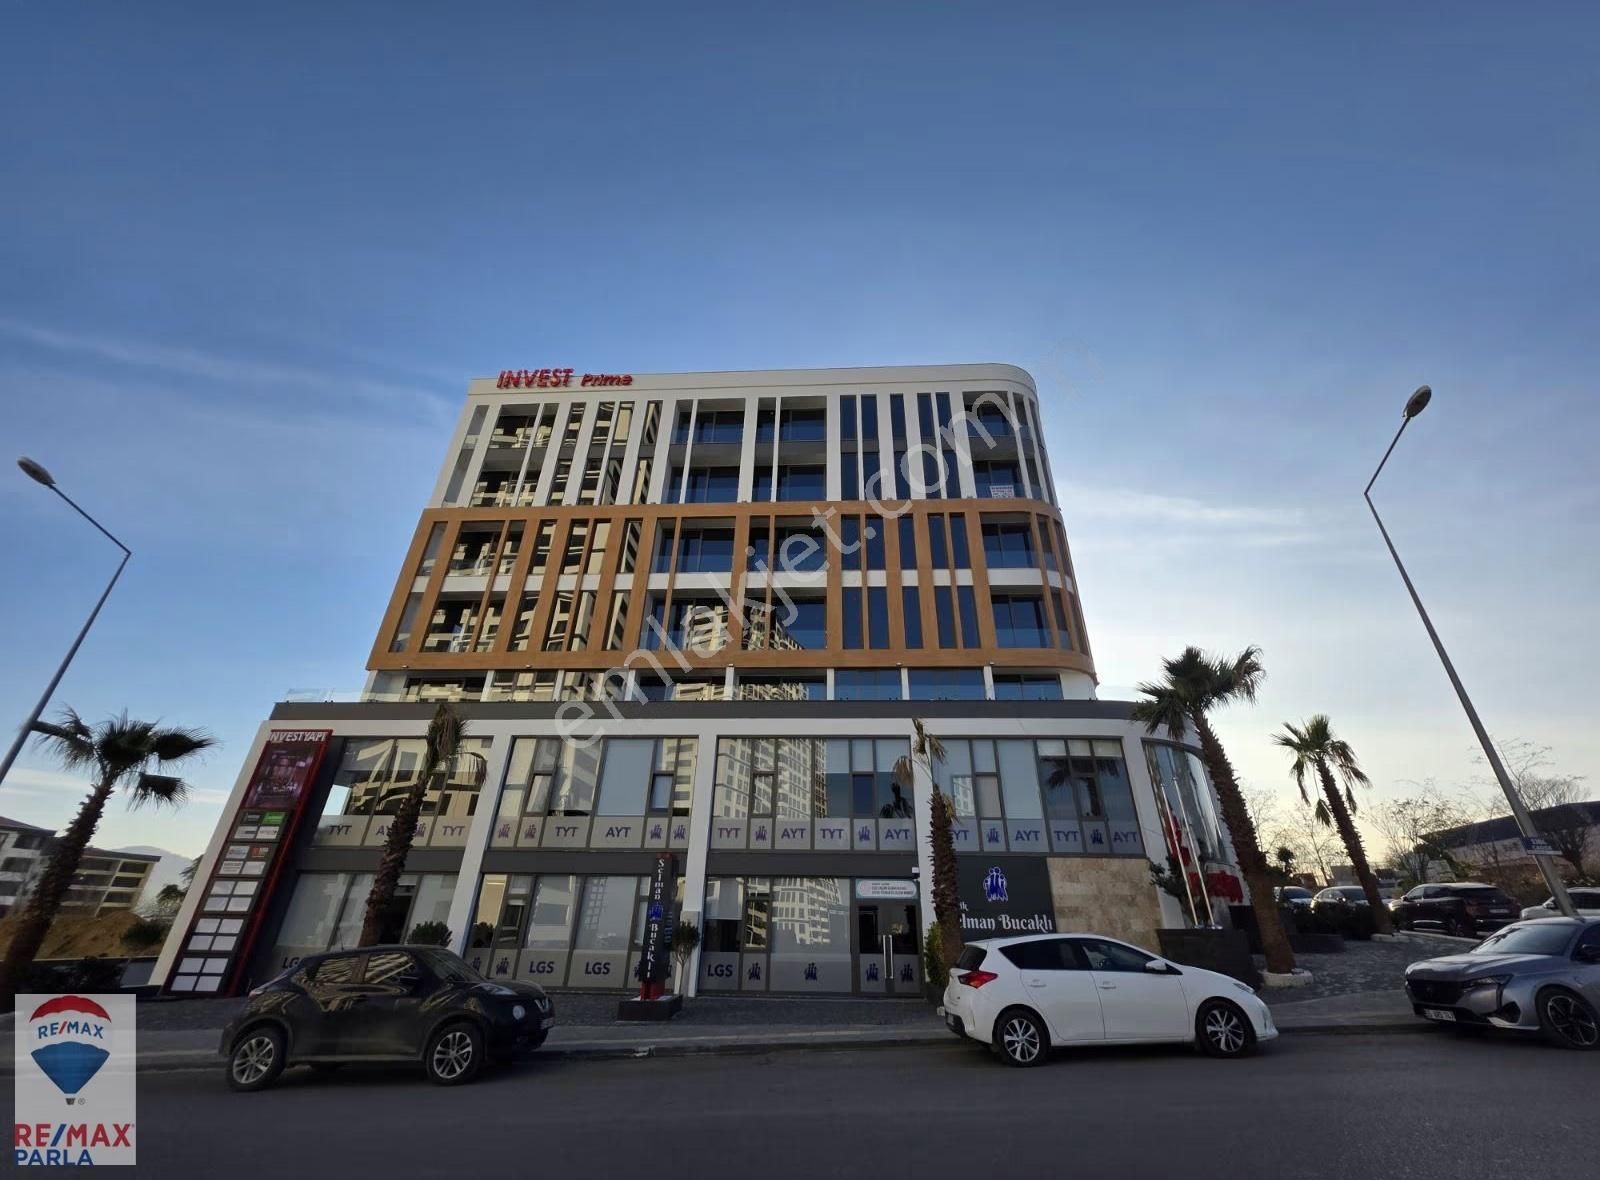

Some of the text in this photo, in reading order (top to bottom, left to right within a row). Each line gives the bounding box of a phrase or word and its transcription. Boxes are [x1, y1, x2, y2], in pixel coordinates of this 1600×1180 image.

[496, 367, 633, 390] INVEST Prime
[328, 825, 352, 836] TYT
[442, 825, 466, 836] TYT
[555, 826, 579, 838] TYT
[605, 826, 632, 839] AYT
[717, 827, 741, 839] TYT
[781, 828, 807, 839] AYT
[820, 828, 844, 840] TYT
[884, 828, 911, 841] AYT
[1015, 830, 1040, 842] AYT
[1054, 830, 1080, 843] TYT
[1113, 831, 1138, 843] AYT
[960, 913, 996, 932] lman
[529, 960, 555, 974] LGS
[585, 961, 611, 975] LGS
[707, 964, 734, 977] LGS
